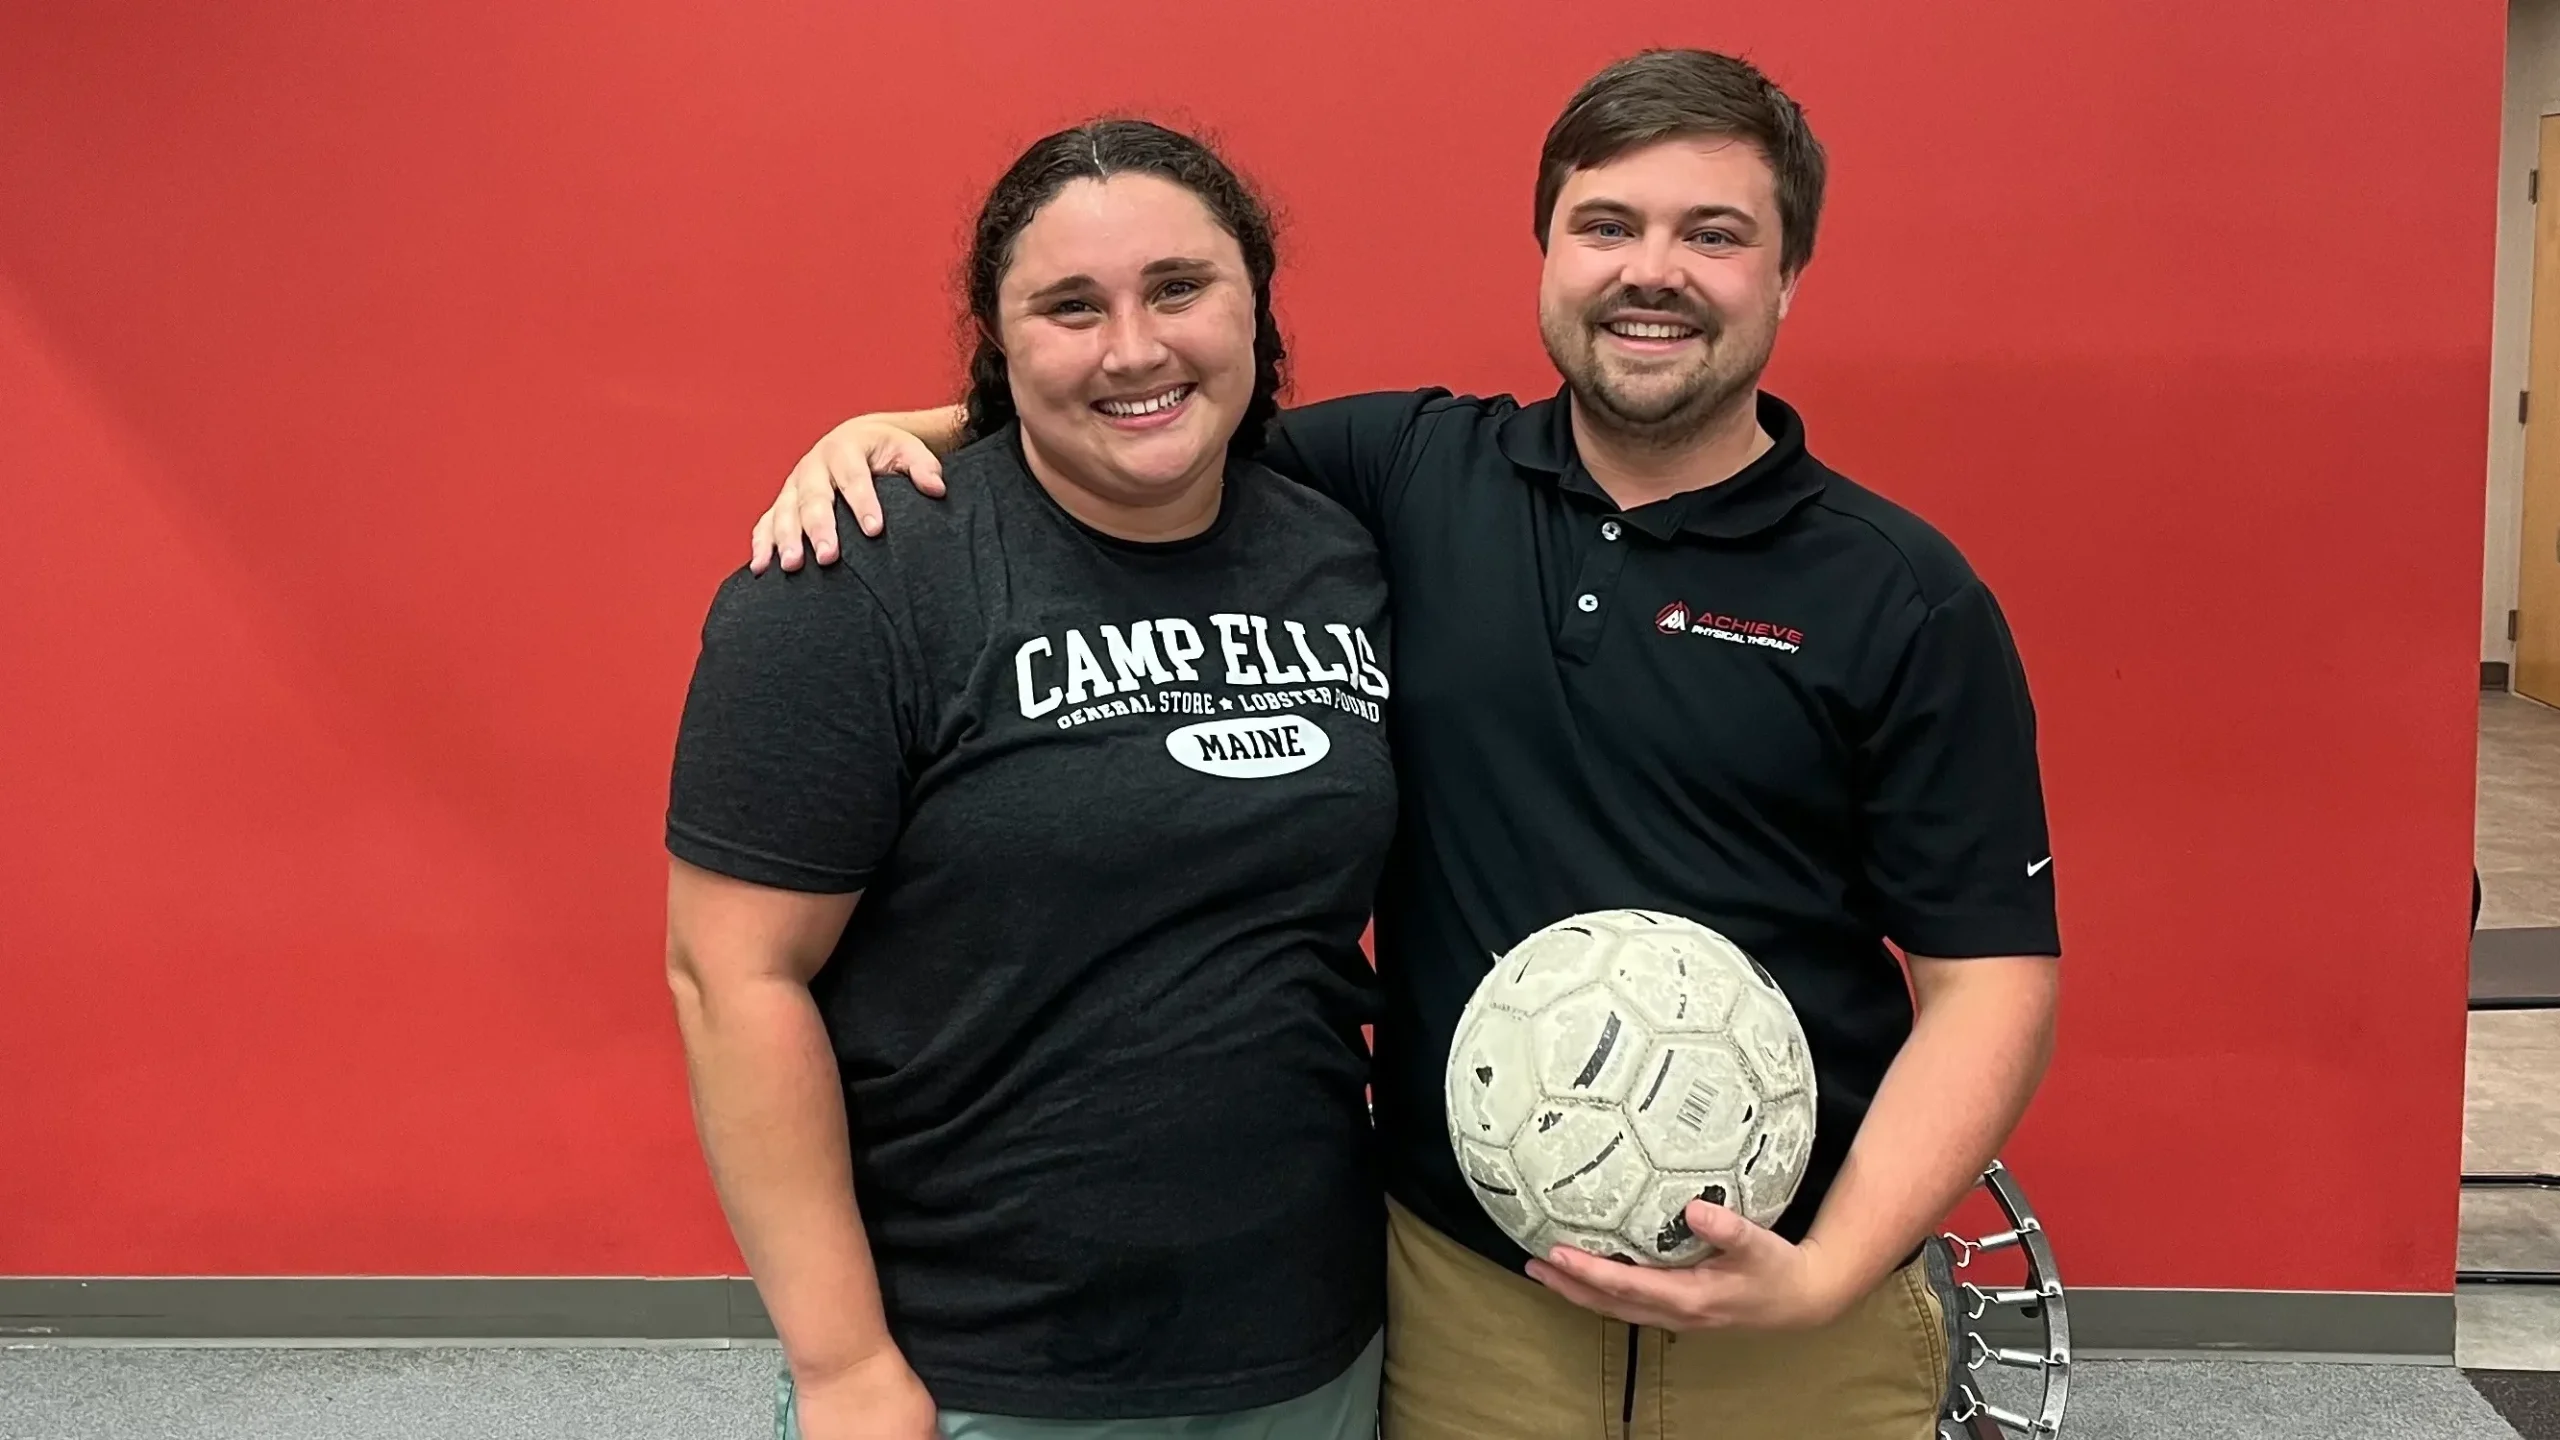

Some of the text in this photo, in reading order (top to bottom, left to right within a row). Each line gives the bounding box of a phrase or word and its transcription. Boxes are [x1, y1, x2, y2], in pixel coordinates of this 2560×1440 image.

[1691, 625, 1799, 653] PHYSICAL THERAPY
[1696, 612, 1804, 644] ACHIEVE
[1015, 613, 1390, 719] CAMP ELLIS
[1056, 686, 1380, 729] GENERAL STORE LOBSTER POUND
[1193, 725, 1305, 762] MAINE
